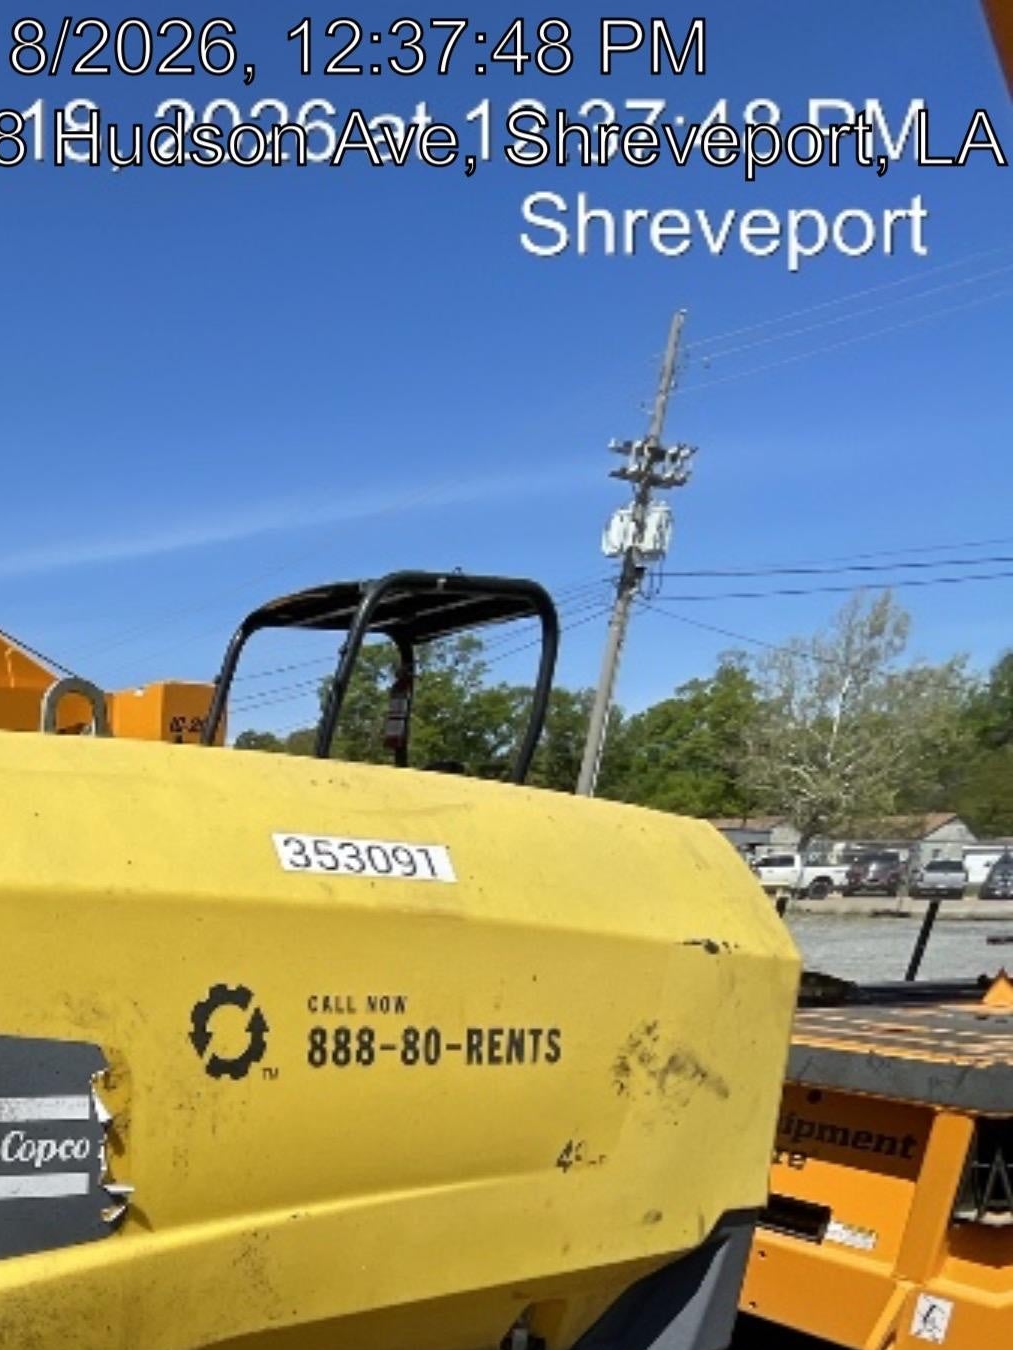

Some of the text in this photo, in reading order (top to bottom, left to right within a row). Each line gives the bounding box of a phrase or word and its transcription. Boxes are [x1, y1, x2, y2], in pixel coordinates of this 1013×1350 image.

[283, 837, 437, 878] 353091
[307, 995, 409, 1014] CALL NOW
[306, 1025, 562, 1068] 888-80-RENTS
[0, 1129, 91, 1168] Copco
